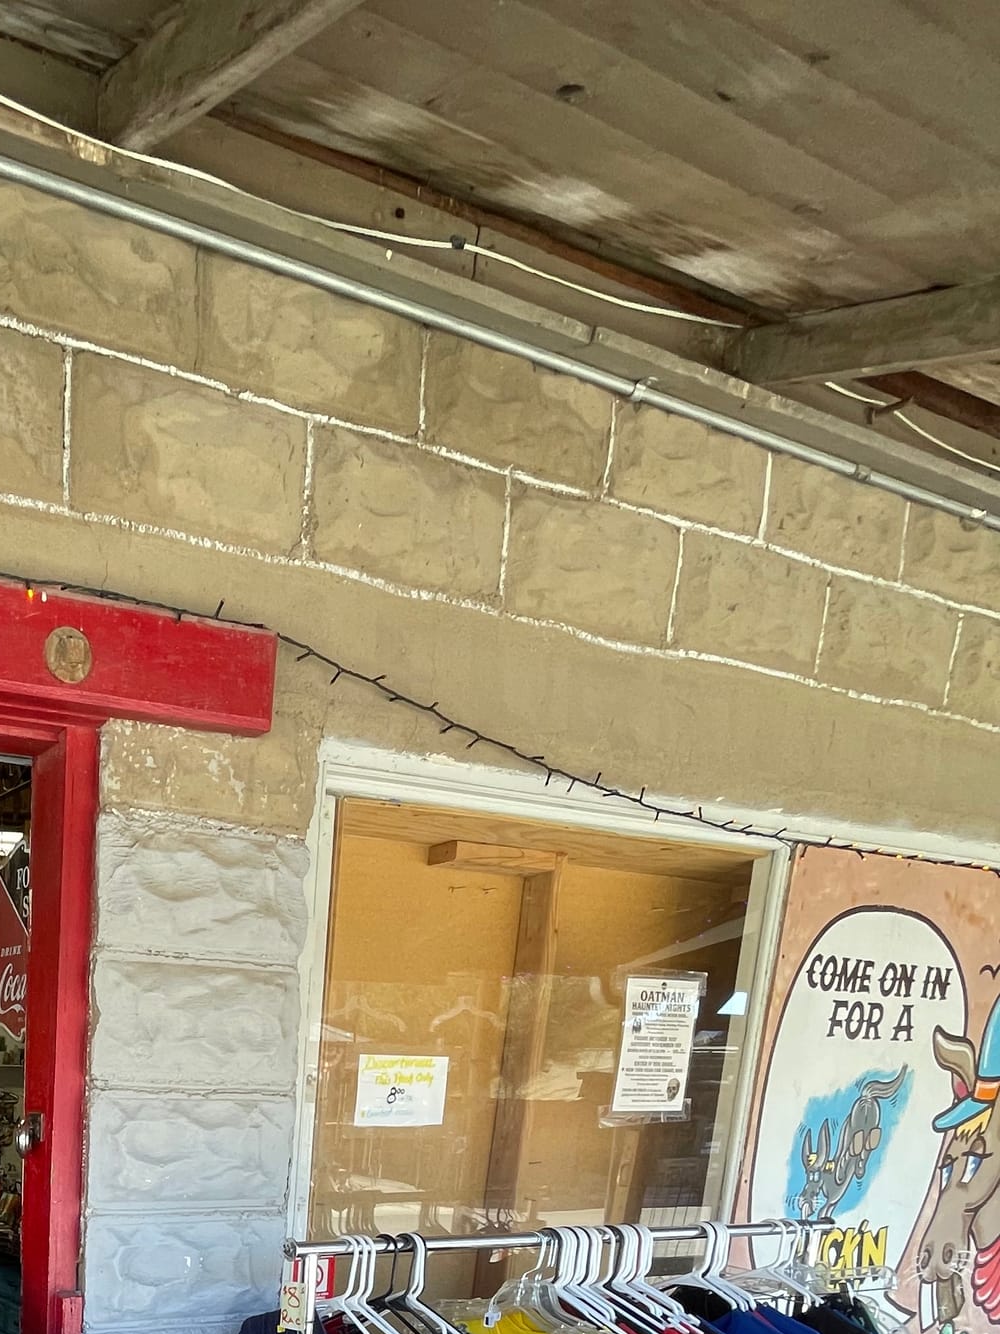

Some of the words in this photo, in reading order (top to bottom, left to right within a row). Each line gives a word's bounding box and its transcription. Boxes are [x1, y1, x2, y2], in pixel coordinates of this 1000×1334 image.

[0, 944, 22, 958] DRINK
[806, 953, 875, 994] COME
[877, 962, 918, 998] ON
[920, 966, 954, 1000] IN
[632, 1002, 662, 1012] HAUNTE
[640, 990, 685, 1003] OATMAN
[826, 1000, 884, 1040] FOR
[890, 1004, 915, 1042] A
[815, 1219, 888, 1289] CK'N
